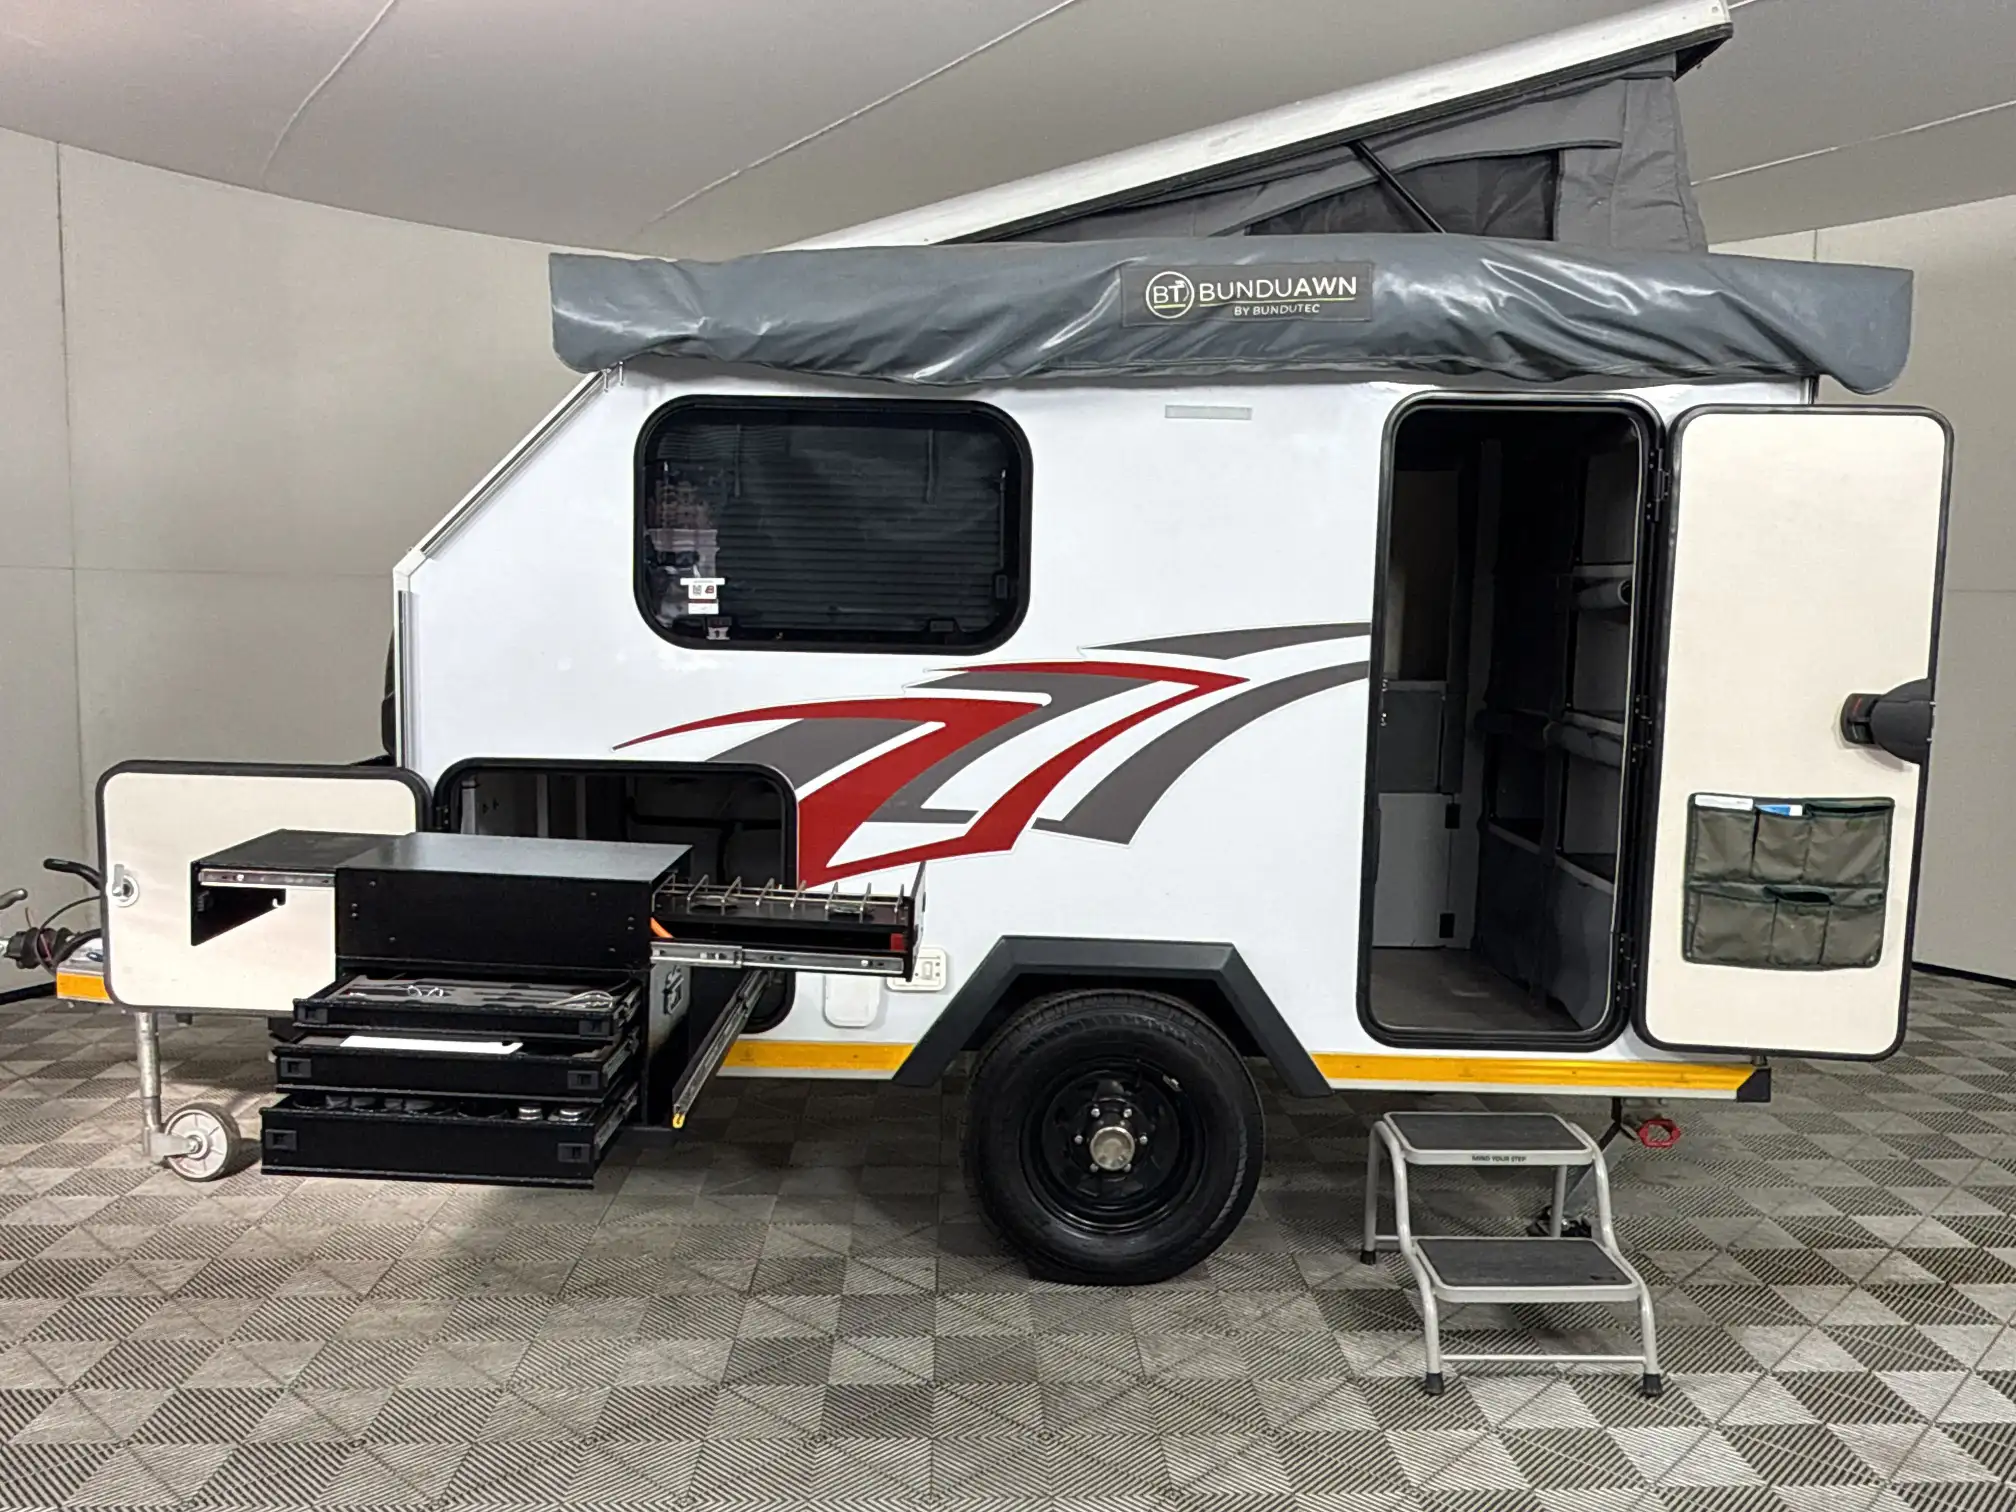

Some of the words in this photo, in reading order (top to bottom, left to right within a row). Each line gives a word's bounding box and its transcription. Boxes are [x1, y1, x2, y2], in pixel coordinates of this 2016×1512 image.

[1199, 276, 1357, 302] BUNDUAWN
[1234, 306, 1250, 316] BY
[1253, 304, 1321, 316] BUNDUTEC
